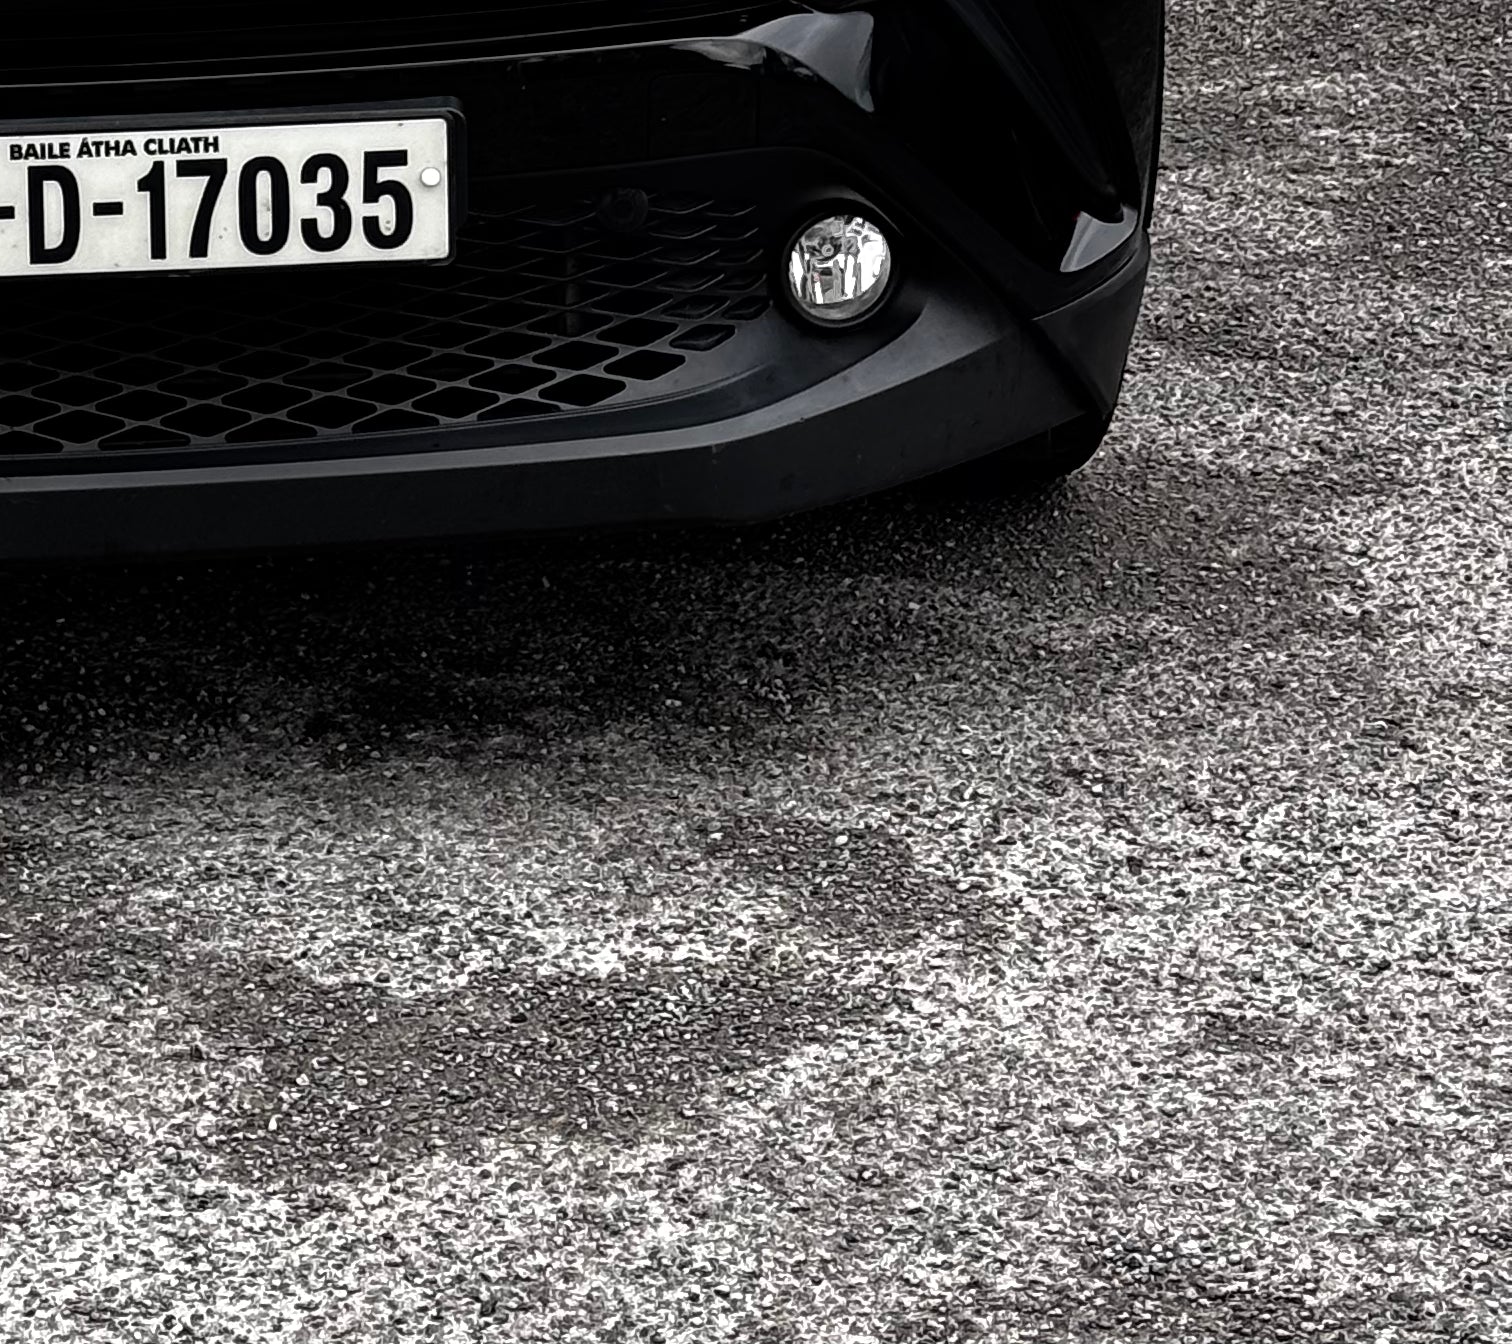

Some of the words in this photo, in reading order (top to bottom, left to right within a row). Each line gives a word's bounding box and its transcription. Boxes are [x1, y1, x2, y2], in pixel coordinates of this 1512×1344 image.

[9, 142, 71, 160] BAILE
[77, 137, 138, 158] ÁTHA
[143, 136, 221, 156] CLIATH
